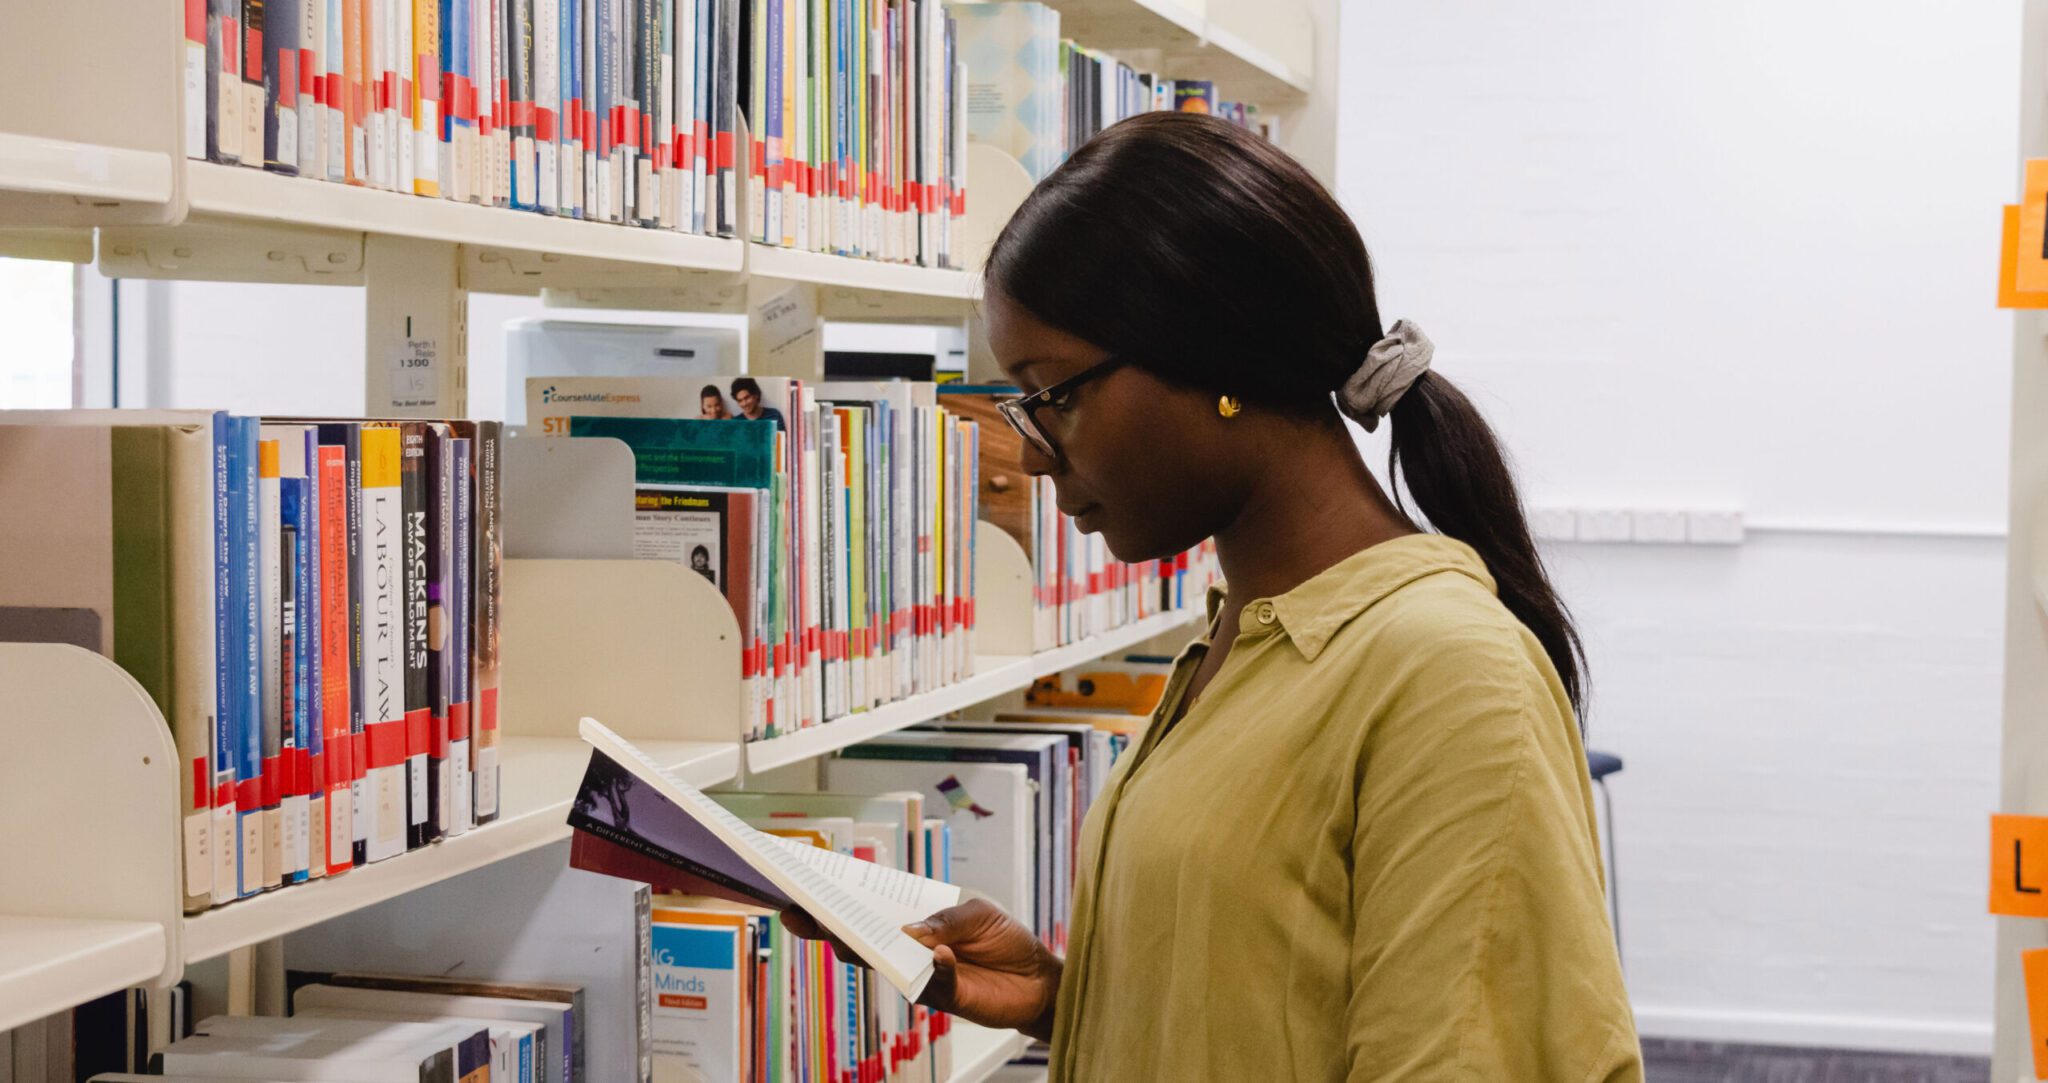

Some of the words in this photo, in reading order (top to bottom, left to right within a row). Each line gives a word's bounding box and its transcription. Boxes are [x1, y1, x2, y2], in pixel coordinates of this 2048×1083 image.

[400, 359, 430, 368] 1300
[551, 393, 641, 403] CourseMateExpress
[335, 478, 343, 509] THE
[349, 460, 357, 529] Employment
[376, 496, 388, 643] LABOUR
[408, 547, 415, 567] OF
[248, 541, 256, 629] PSYCHOLOGY
[415, 511, 427, 669] MACKEN'S
[283, 599, 296, 636] THE
[248, 633, 256, 661] AND
[248, 666, 257, 696] LAW
[377, 657, 389, 723] LAW
[595, 825, 644, 851] DIFFERENT
[645, 846, 670, 861] KIND
[670, 856, 685, 866] OF
[689, 864, 730, 885] SUBJECT
[2014, 838, 2042, 894] L
[655, 973, 706, 993] Minds
